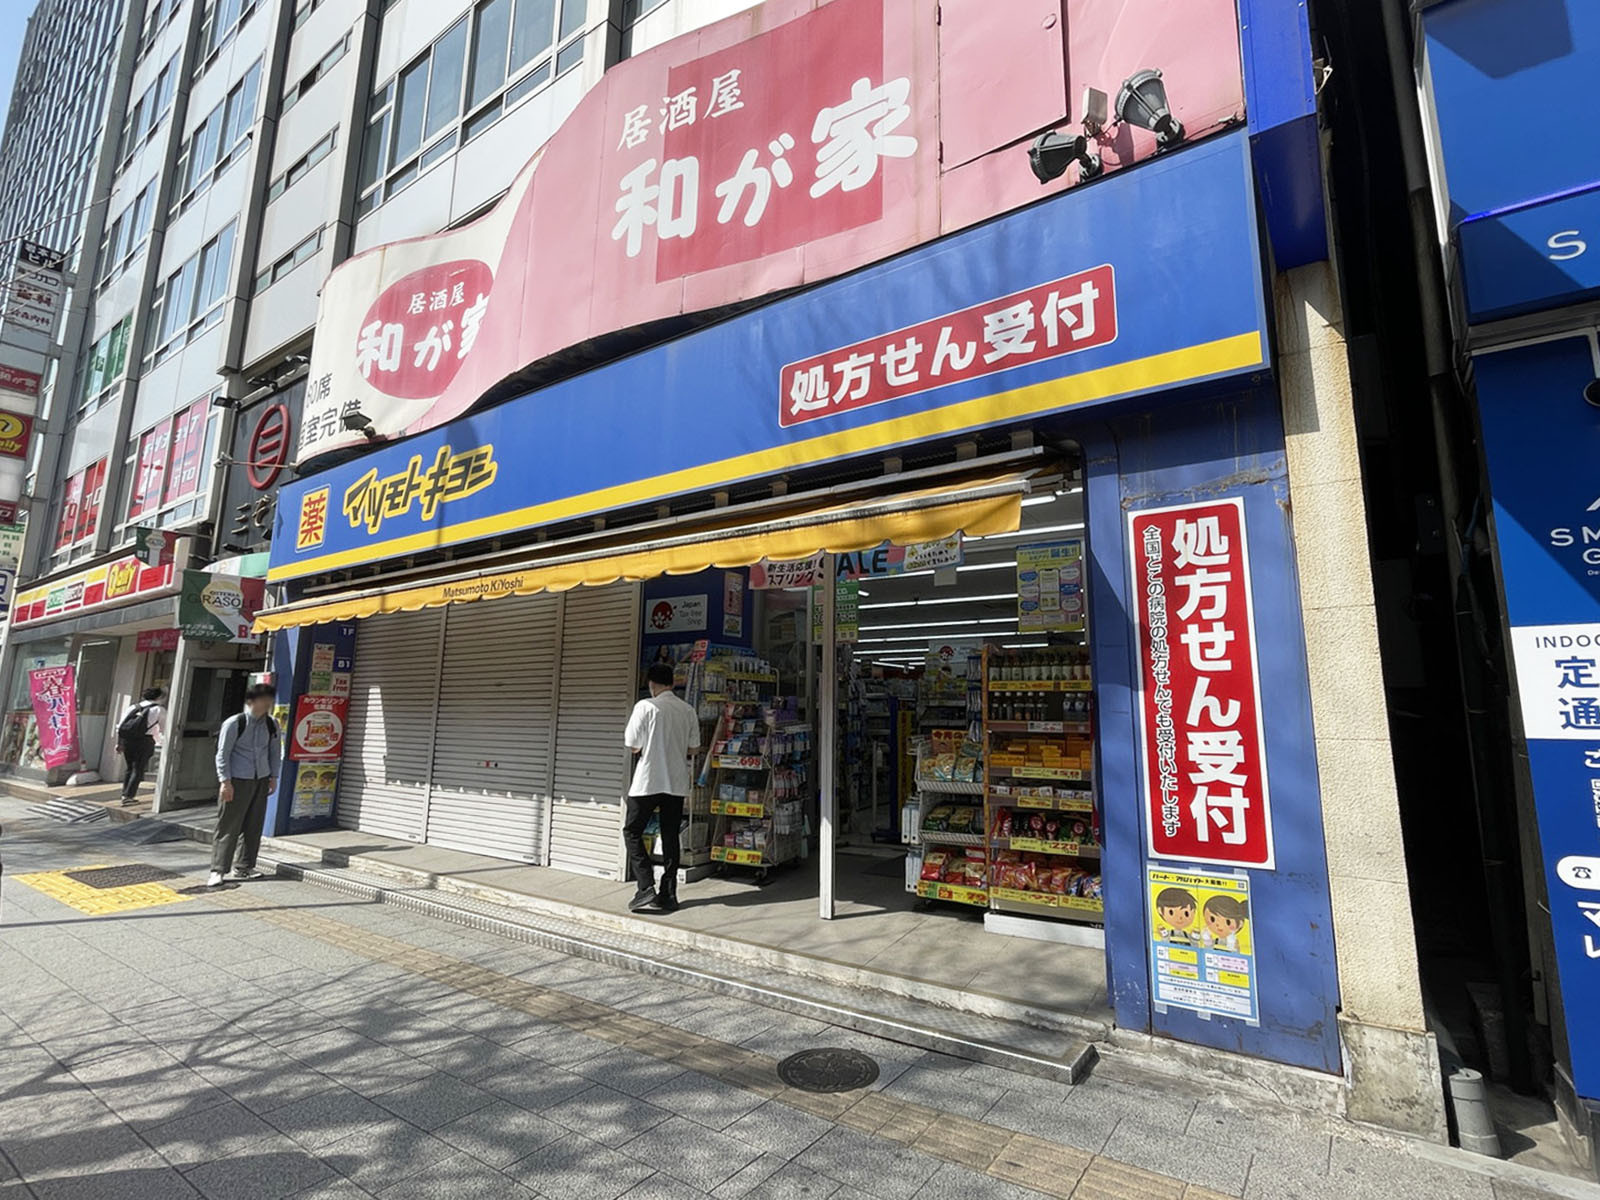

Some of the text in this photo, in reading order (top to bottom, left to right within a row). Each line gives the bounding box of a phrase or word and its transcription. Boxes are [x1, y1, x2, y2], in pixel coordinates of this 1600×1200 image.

[617, 69, 744, 151] 居酒屋
[611, 77, 918, 258] 和が家
[407, 281, 465, 315] 居酒屋
[790, 280, 1099, 416] 処方せん受付
[299, 493, 326, 546] 薬
[344, 446, 496, 532] マツモトキヨシ
[443, 576, 524, 598] Matsumoto KiYoshi
[1143, 525, 1180, 837] 全国どこの病院の処方せんでも受付いたします
[1171, 515, 1250, 845] 処方せん受付
